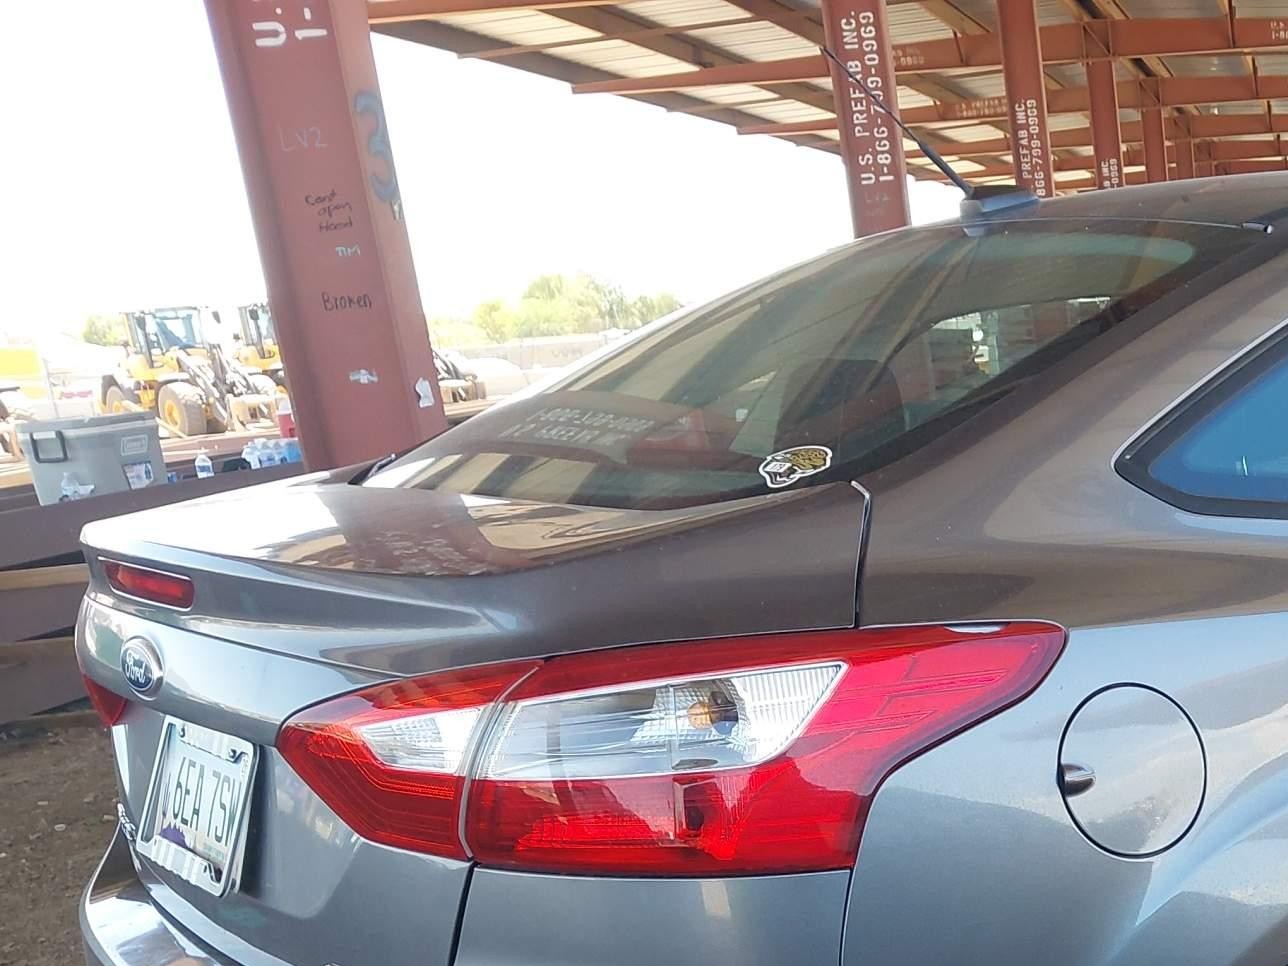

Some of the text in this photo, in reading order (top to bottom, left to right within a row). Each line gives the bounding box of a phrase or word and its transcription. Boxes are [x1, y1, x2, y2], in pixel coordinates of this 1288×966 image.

[841, 11, 876, 185] U.S. PREFAB INC.
[859, 11, 895, 182] 1-866-799-0969
[1015, 98, 1032, 179] PREFAB INC.
[321, 291, 372, 312] Broken
[126, 650, 147, 684] Ford
